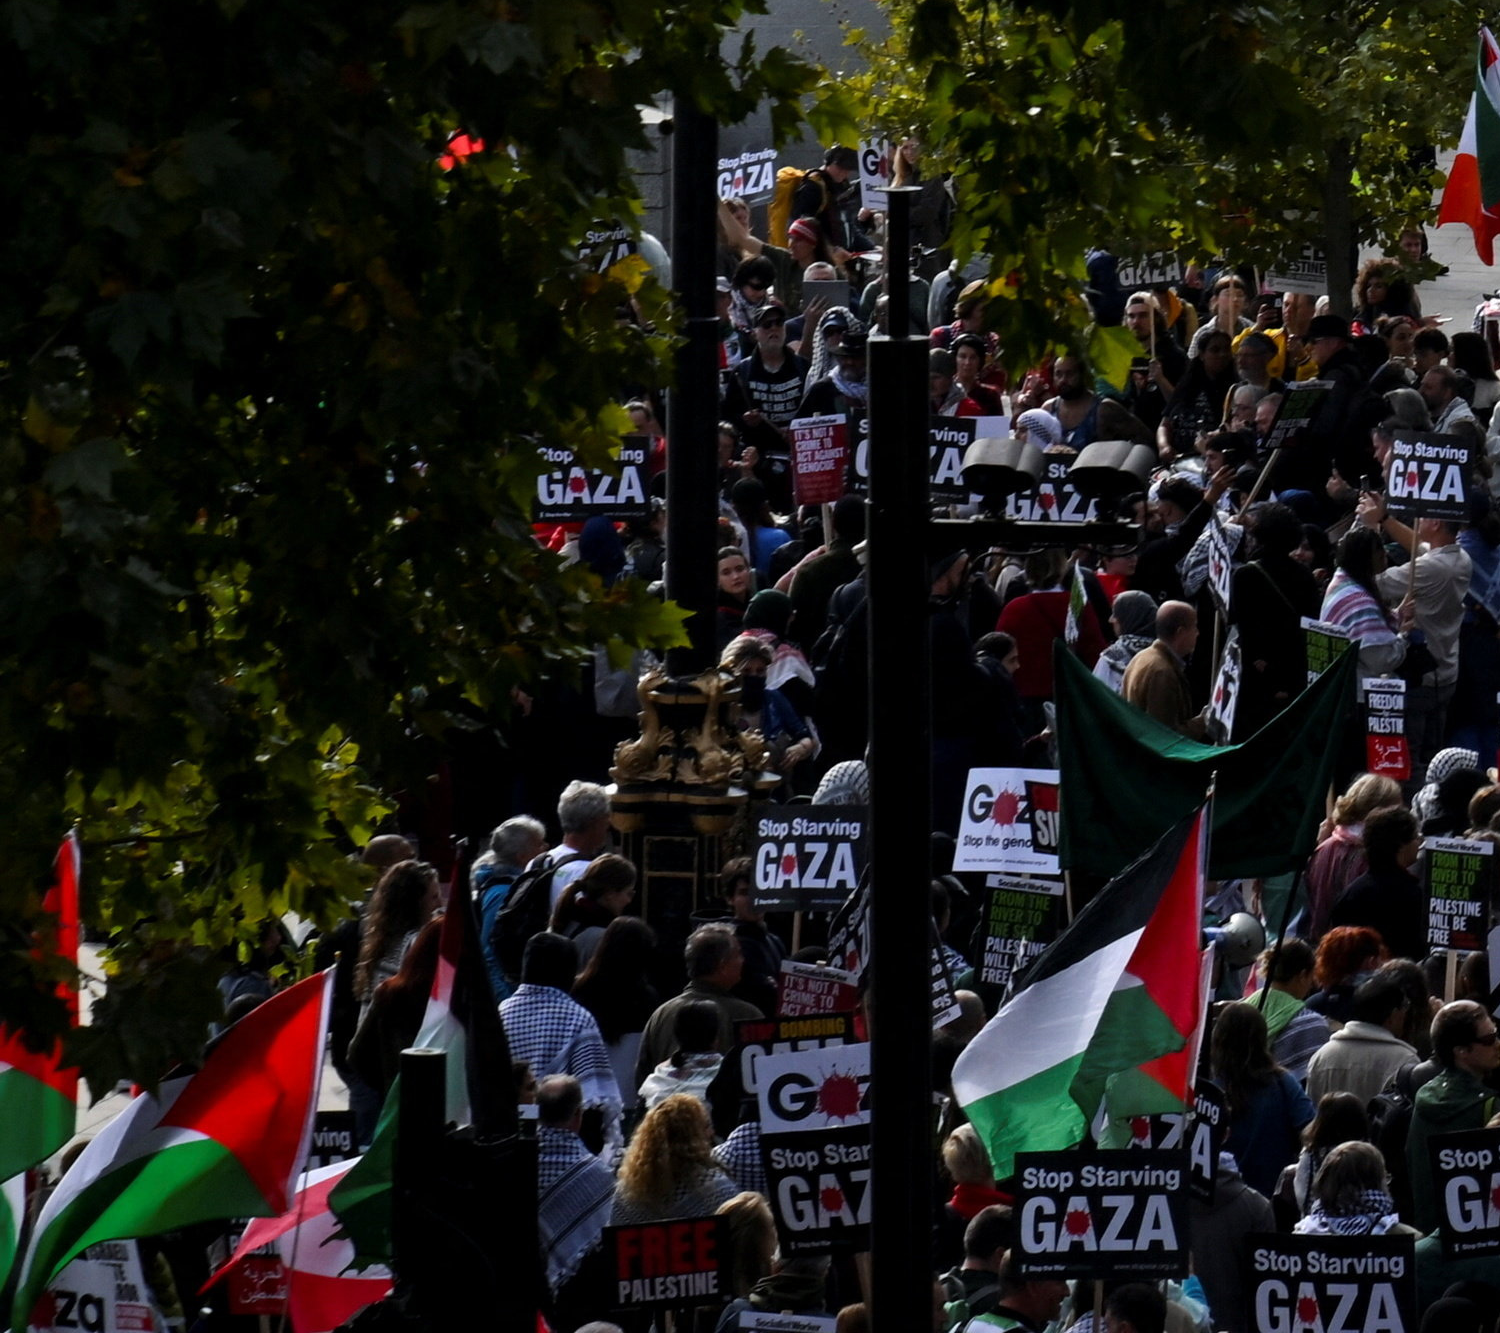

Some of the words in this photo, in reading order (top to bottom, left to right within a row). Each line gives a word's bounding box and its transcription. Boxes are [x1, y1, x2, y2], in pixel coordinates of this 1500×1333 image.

[717, 157, 738, 171] Stop
[740, 148, 778, 165] Starving
[717, 162, 775, 201] GAZA
[1022, 1166, 1076, 1190] Stop
[1080, 1164, 1180, 1191] Starving
[1020, 1195, 1180, 1254] GAZA
